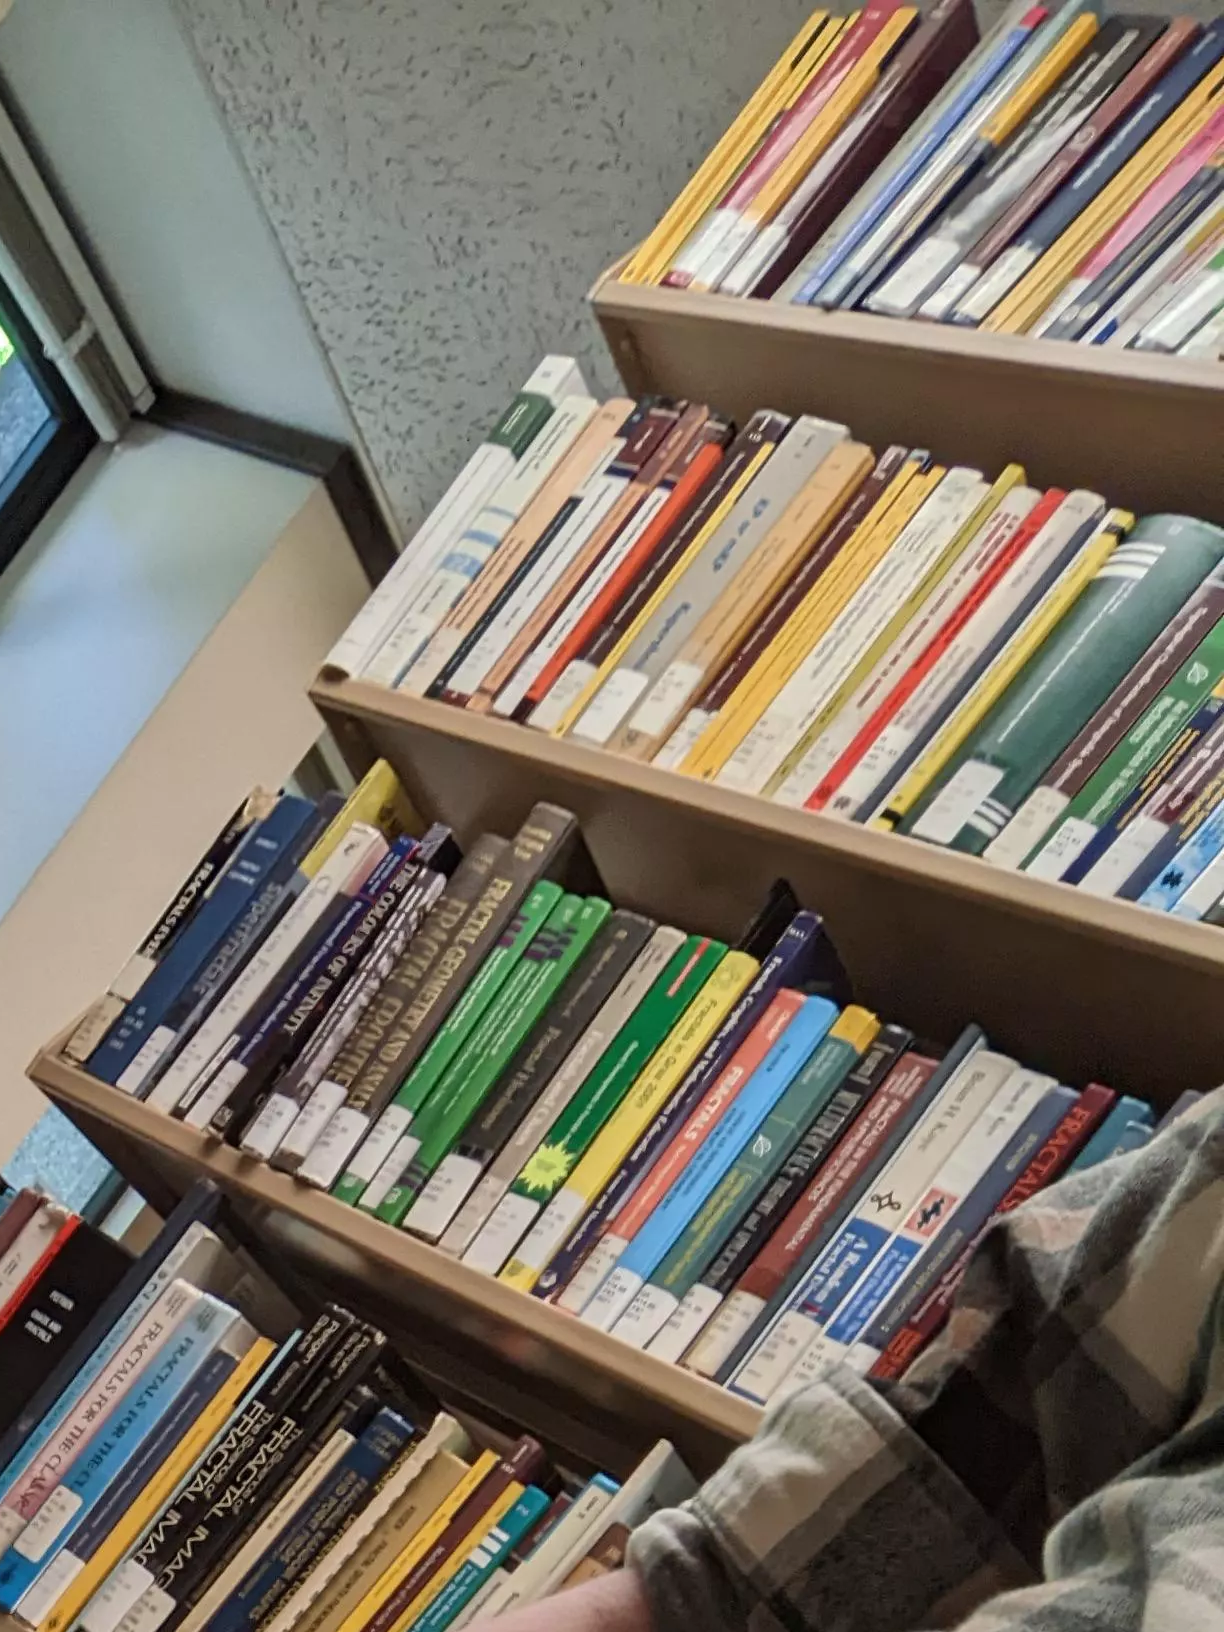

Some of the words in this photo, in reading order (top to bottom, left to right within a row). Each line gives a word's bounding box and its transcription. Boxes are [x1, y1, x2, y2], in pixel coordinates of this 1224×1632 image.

[161, 859, 215, 929] FRACTALS
[386, 858, 420, 895] THE
[338, 889, 397, 958] COLOURS
[452, 873, 513, 950] FRACTAL
[324, 952, 348, 978] OF
[397, 941, 468, 1032] GEOMETRY
[279, 973, 332, 1036] INFINITY
[679, 996, 718, 1044] Fractals
[374, 1023, 412, 1066] AND
[679, 1061, 744, 1144] FRACTALS
[998, 1103, 1090, 1213] FRACTALS
[101, 1320, 163, 1395] FRACTALS
[132, 1335, 194, 1410] FRACTALS
[78, 1390, 108, 1426] FOR
[109, 1407, 138, 1441] FOR
[249, 1407, 275, 1437] The
[56, 1420, 85, 1455] THE
[84, 1439, 113, 1473] THE
[173, 1397, 265, 1511] FRACTAL
[213, 1432, 256, 1482] Science
[278, 1424, 303, 1453] The
[199, 1478, 220, 1501] of
[201, 1414, 295, 1526] FRACTAL
[241, 1448, 284, 1499] Science
[227, 1494, 248, 1517] of
